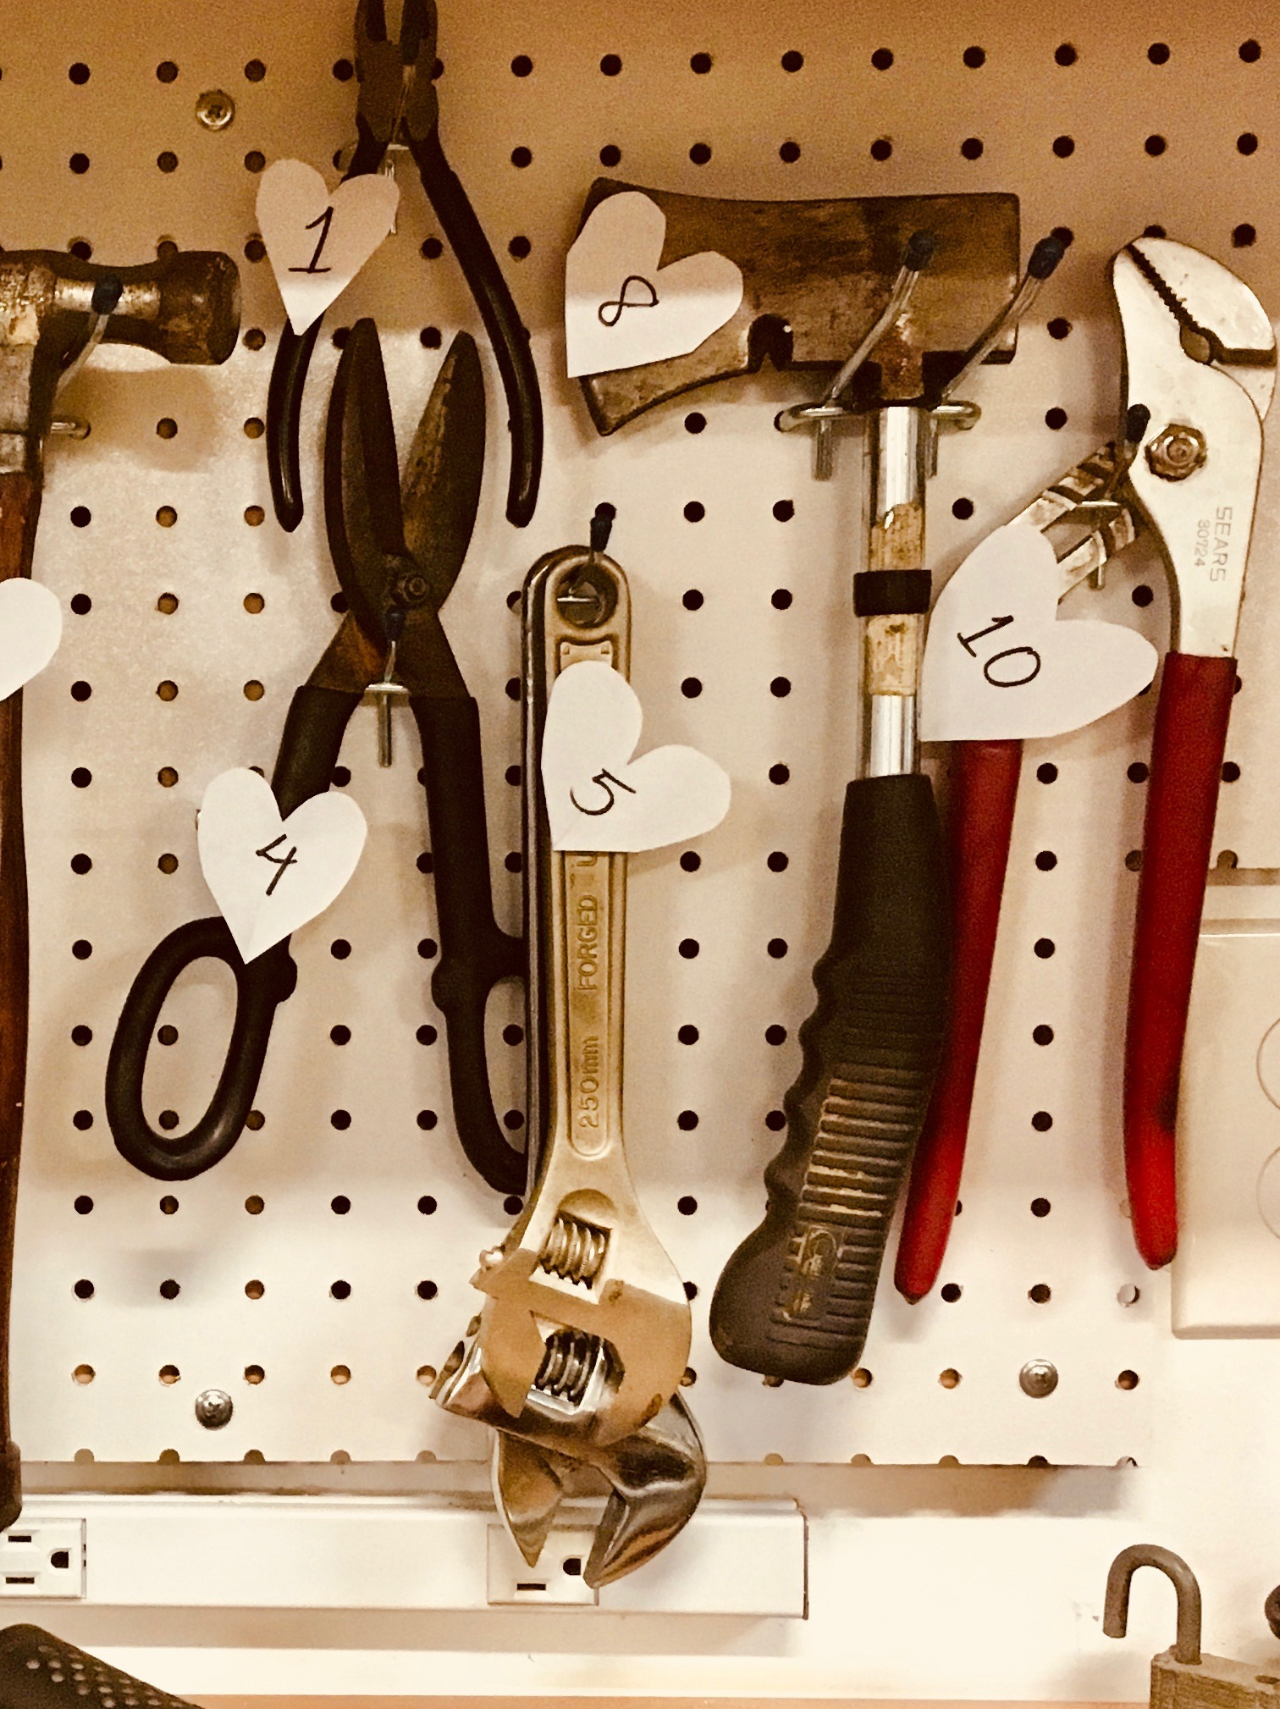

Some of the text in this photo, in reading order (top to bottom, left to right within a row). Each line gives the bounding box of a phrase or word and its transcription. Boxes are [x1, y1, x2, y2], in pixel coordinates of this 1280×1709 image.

[287, 205, 335, 275] 1
[598, 274, 660, 327] 8
[1194, 519, 1211, 568] 30724
[1209, 506, 1233, 582] SEARS
[956, 614, 1042, 688] 10
[570, 768, 637, 816] 5
[255, 833, 298, 897] 4
[576, 893, 598, 991] FORGED
[579, 1035, 600, 1129] 250mm
